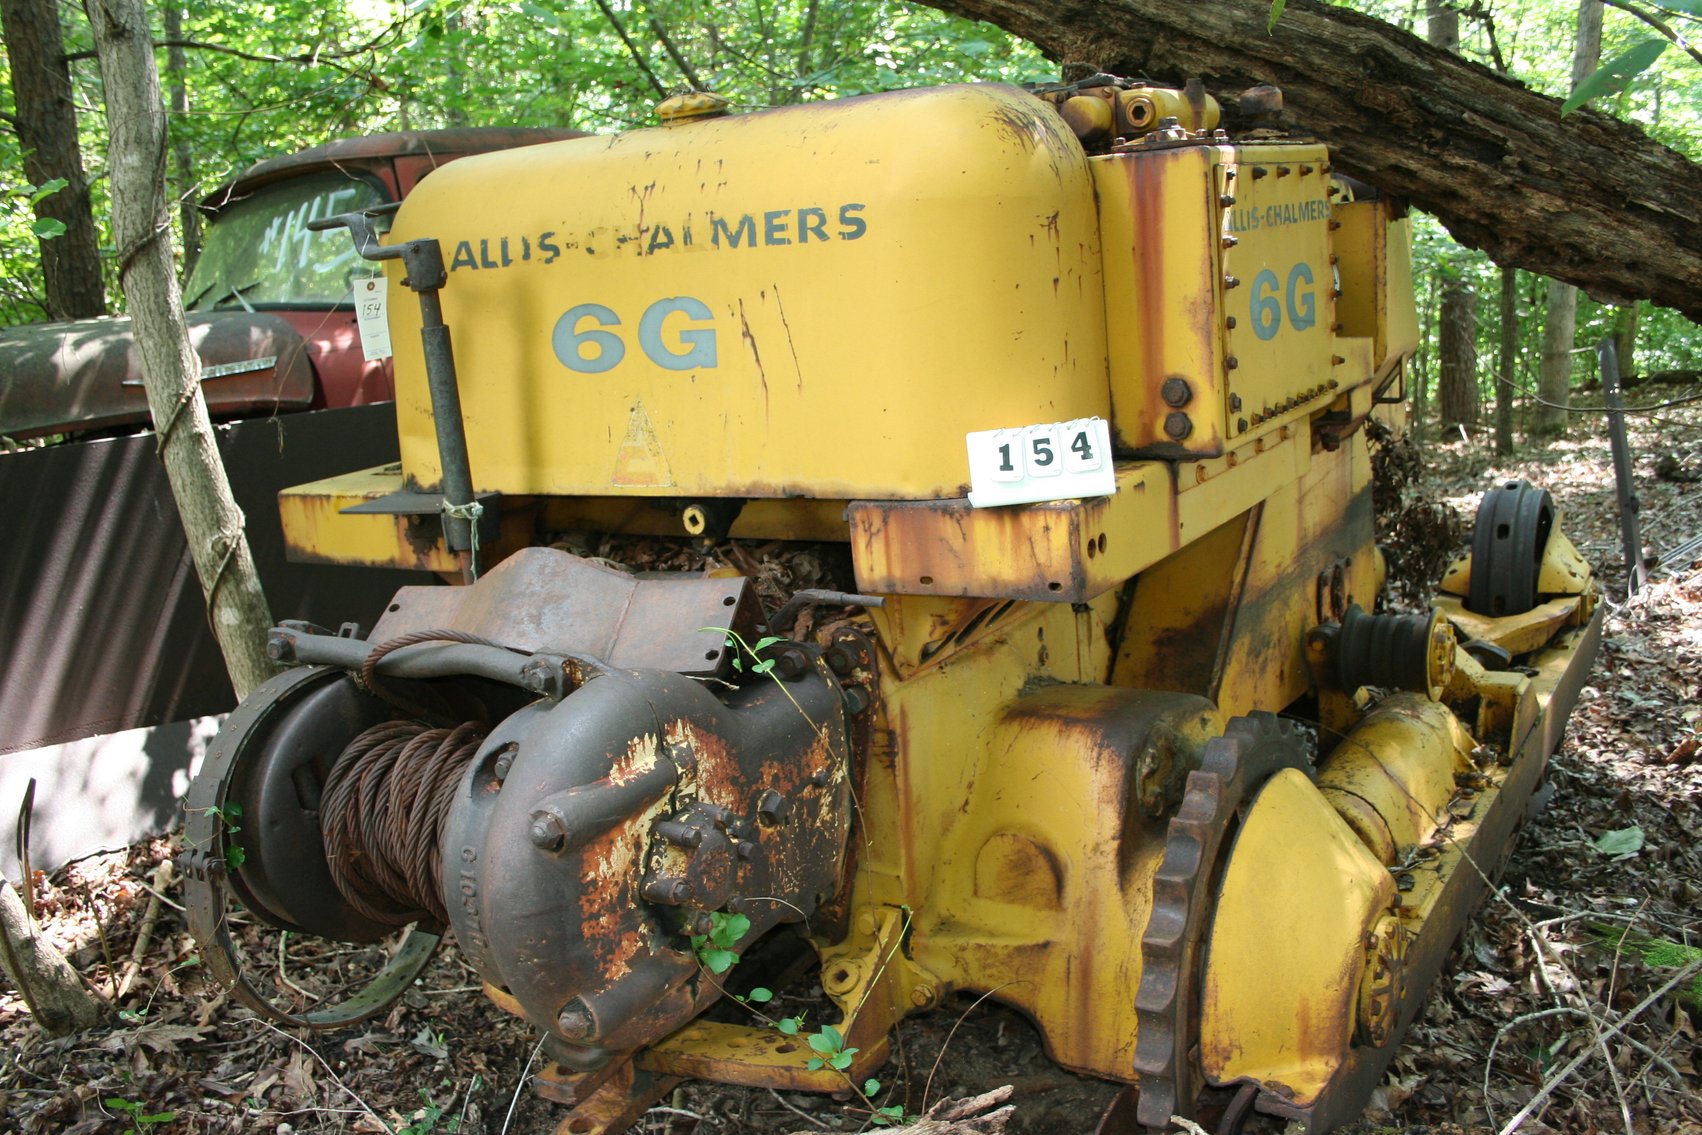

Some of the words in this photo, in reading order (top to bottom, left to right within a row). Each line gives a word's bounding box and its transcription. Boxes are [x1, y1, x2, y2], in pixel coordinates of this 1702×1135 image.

[362, 302, 382, 316] 154
[1250, 262, 1315, 341] 6G
[552, 296, 718, 374] 6G
[999, 431, 1094, 472] 154
